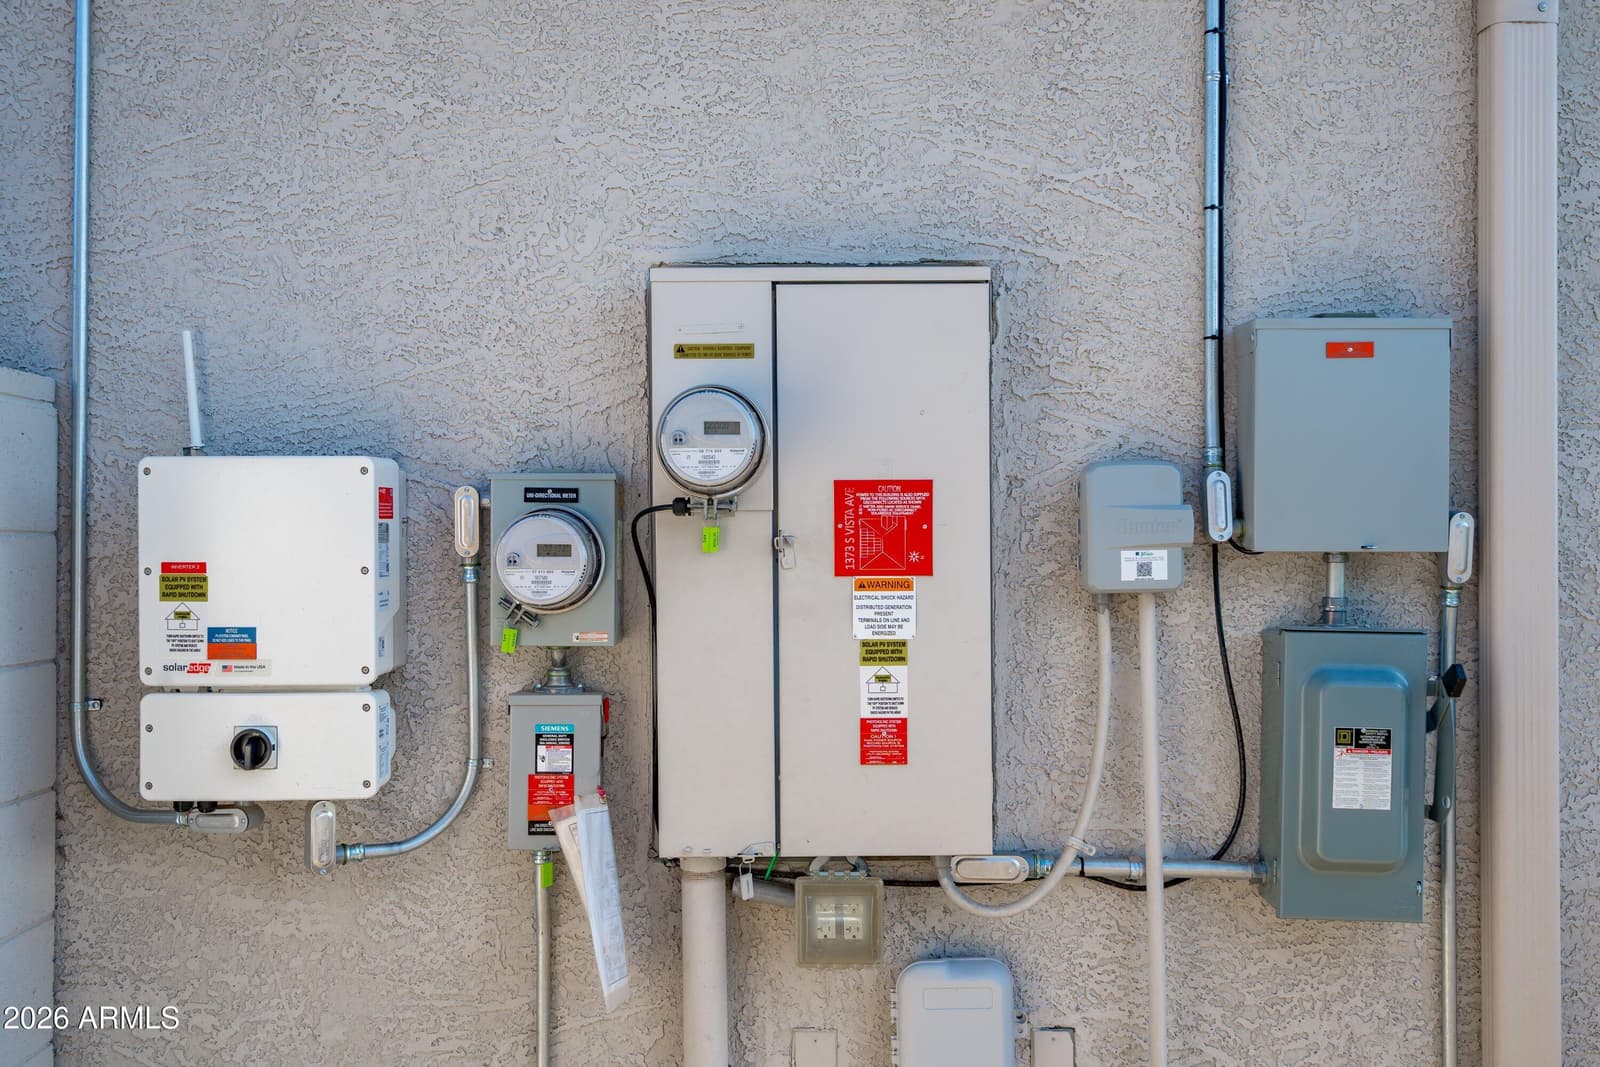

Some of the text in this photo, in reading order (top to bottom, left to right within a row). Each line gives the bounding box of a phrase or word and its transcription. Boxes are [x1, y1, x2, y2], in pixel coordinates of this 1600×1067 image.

[844, 508, 855, 536] VISTA
[844, 545, 855, 570] 1373
[163, 662, 212, 673] solaredge
